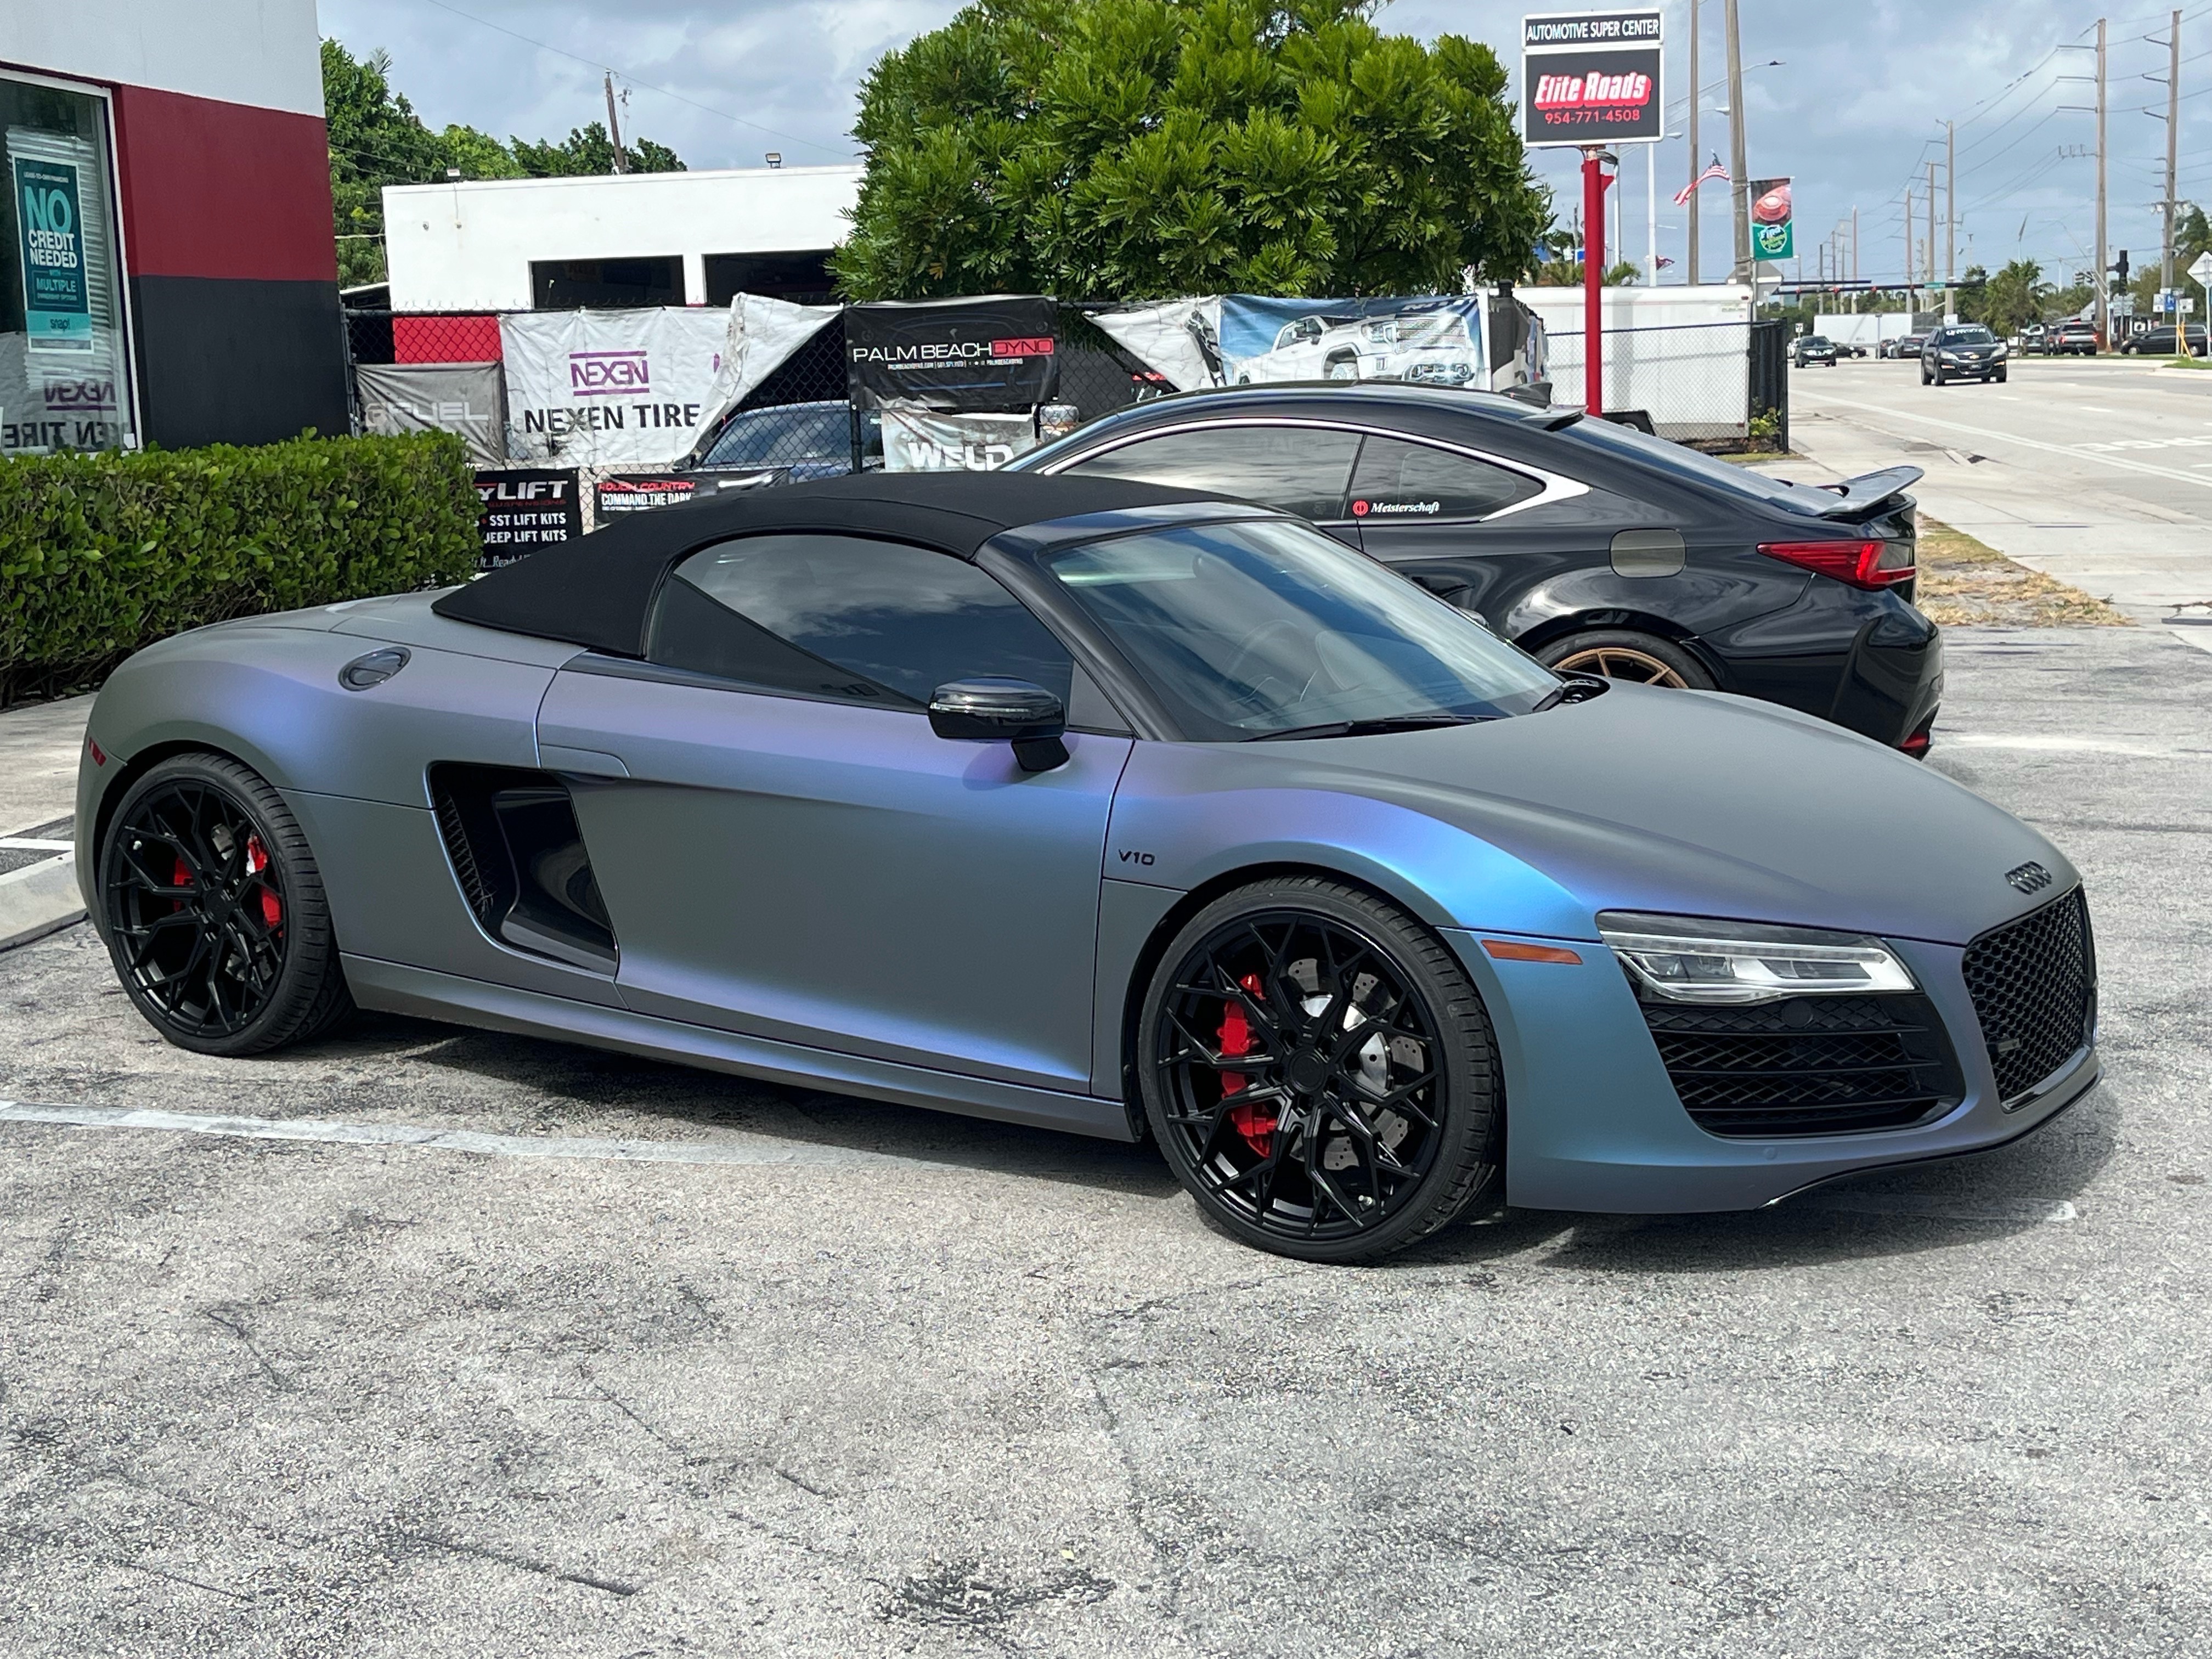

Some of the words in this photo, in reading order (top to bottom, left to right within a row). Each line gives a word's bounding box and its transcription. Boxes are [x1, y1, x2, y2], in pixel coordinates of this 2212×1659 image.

[1527, 22, 1588, 41] AUTOMOTIVE
[1590, 21, 1620, 37] SUPER
[1622, 19, 1659, 36] CENTER
[1534, 74, 1583, 108] Elite
[1583, 71, 1650, 105] Roads
[1545, 109, 1640, 125] 954-771-4508
[24, 185, 72, 234] NO
[28, 229, 75, 251] CREDIT
[30, 248, 77, 268] NEEDED
[36, 278, 76, 292] MULTIPLE
[853, 346, 917, 362] PALM
[570, 360, 649, 387] NEXEN
[524, 405, 624, 433] NEXEN
[633, 404, 700, 428] TIRE
[908, 442, 1014, 471] WELD
[602, 493, 647, 506] COMMAND
[650, 493, 666, 506] THE
[1371, 501, 1440, 514] Meisterschaft
[489, 515, 510, 526] SST
[514, 514, 537, 526] LIFT
[540, 512, 566, 524] KITS
[484, 531, 511, 544] JEEP
[514, 530, 538, 543] LIFT
[541, 529, 567, 541] KITS
[1119, 849, 1155, 866] V10
